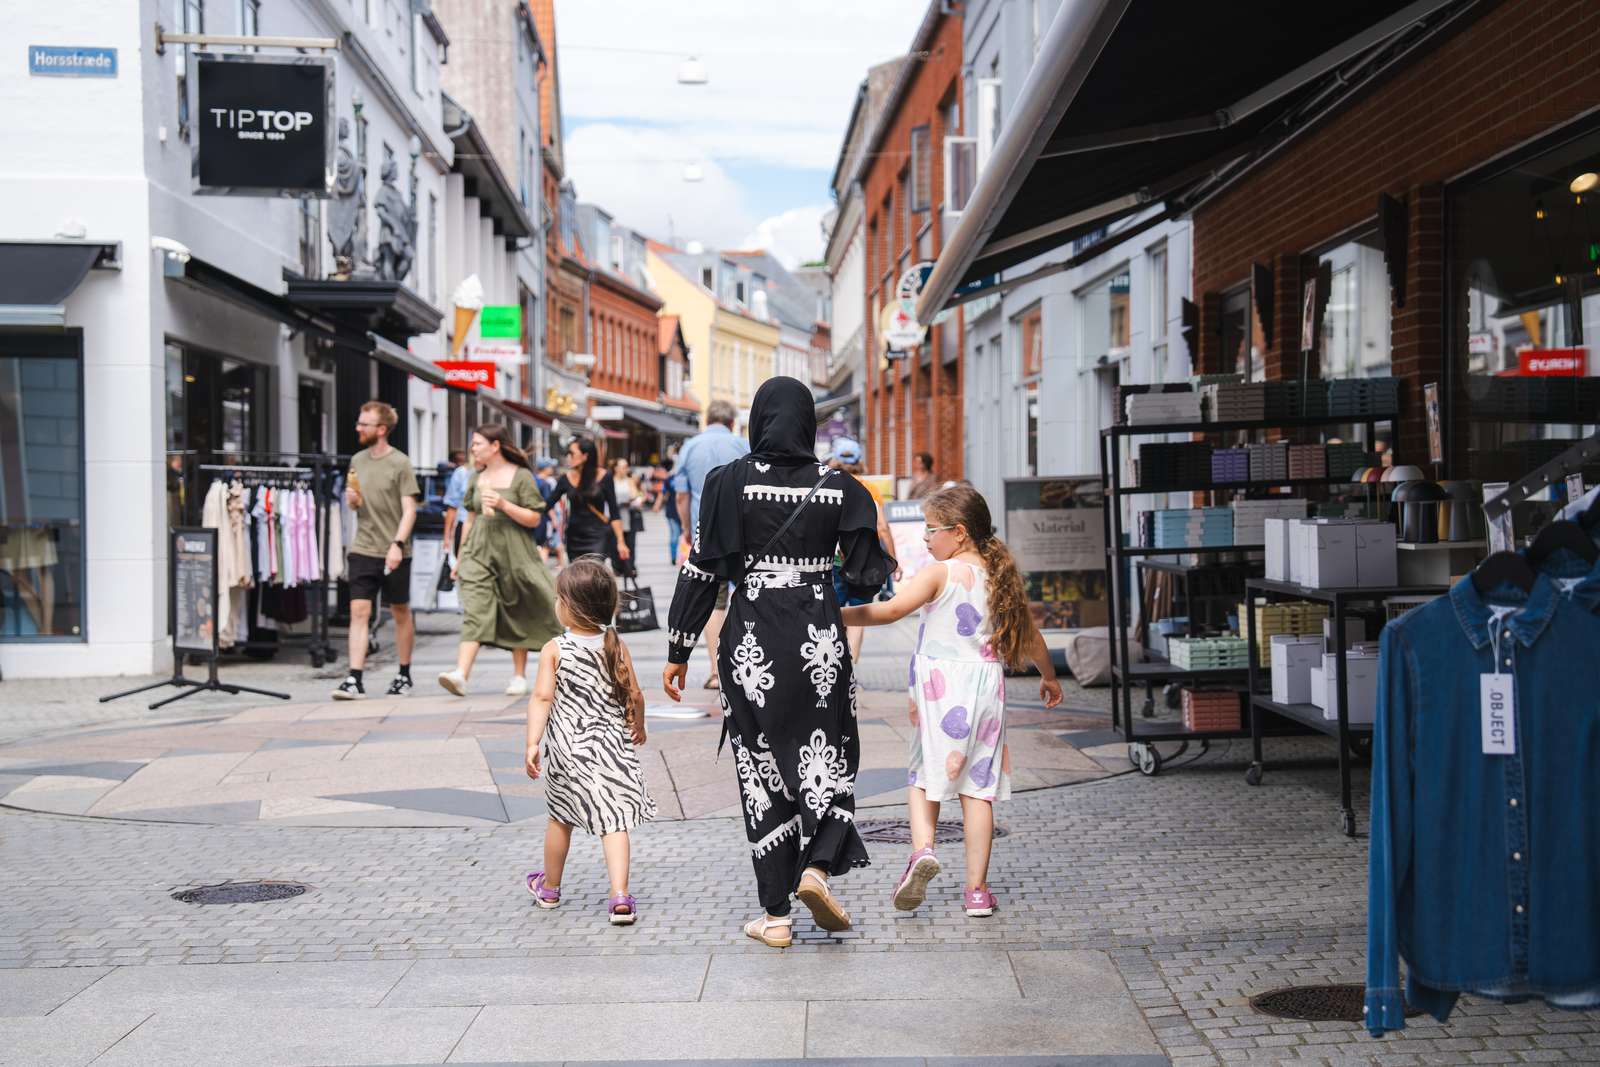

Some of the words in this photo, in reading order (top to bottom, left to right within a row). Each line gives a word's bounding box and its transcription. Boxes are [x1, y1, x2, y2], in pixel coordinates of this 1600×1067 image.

[34, 51, 112, 67] Horsstræde
[238, 130, 265, 140] SINCE
[1032, 519, 1086, 533] Material
